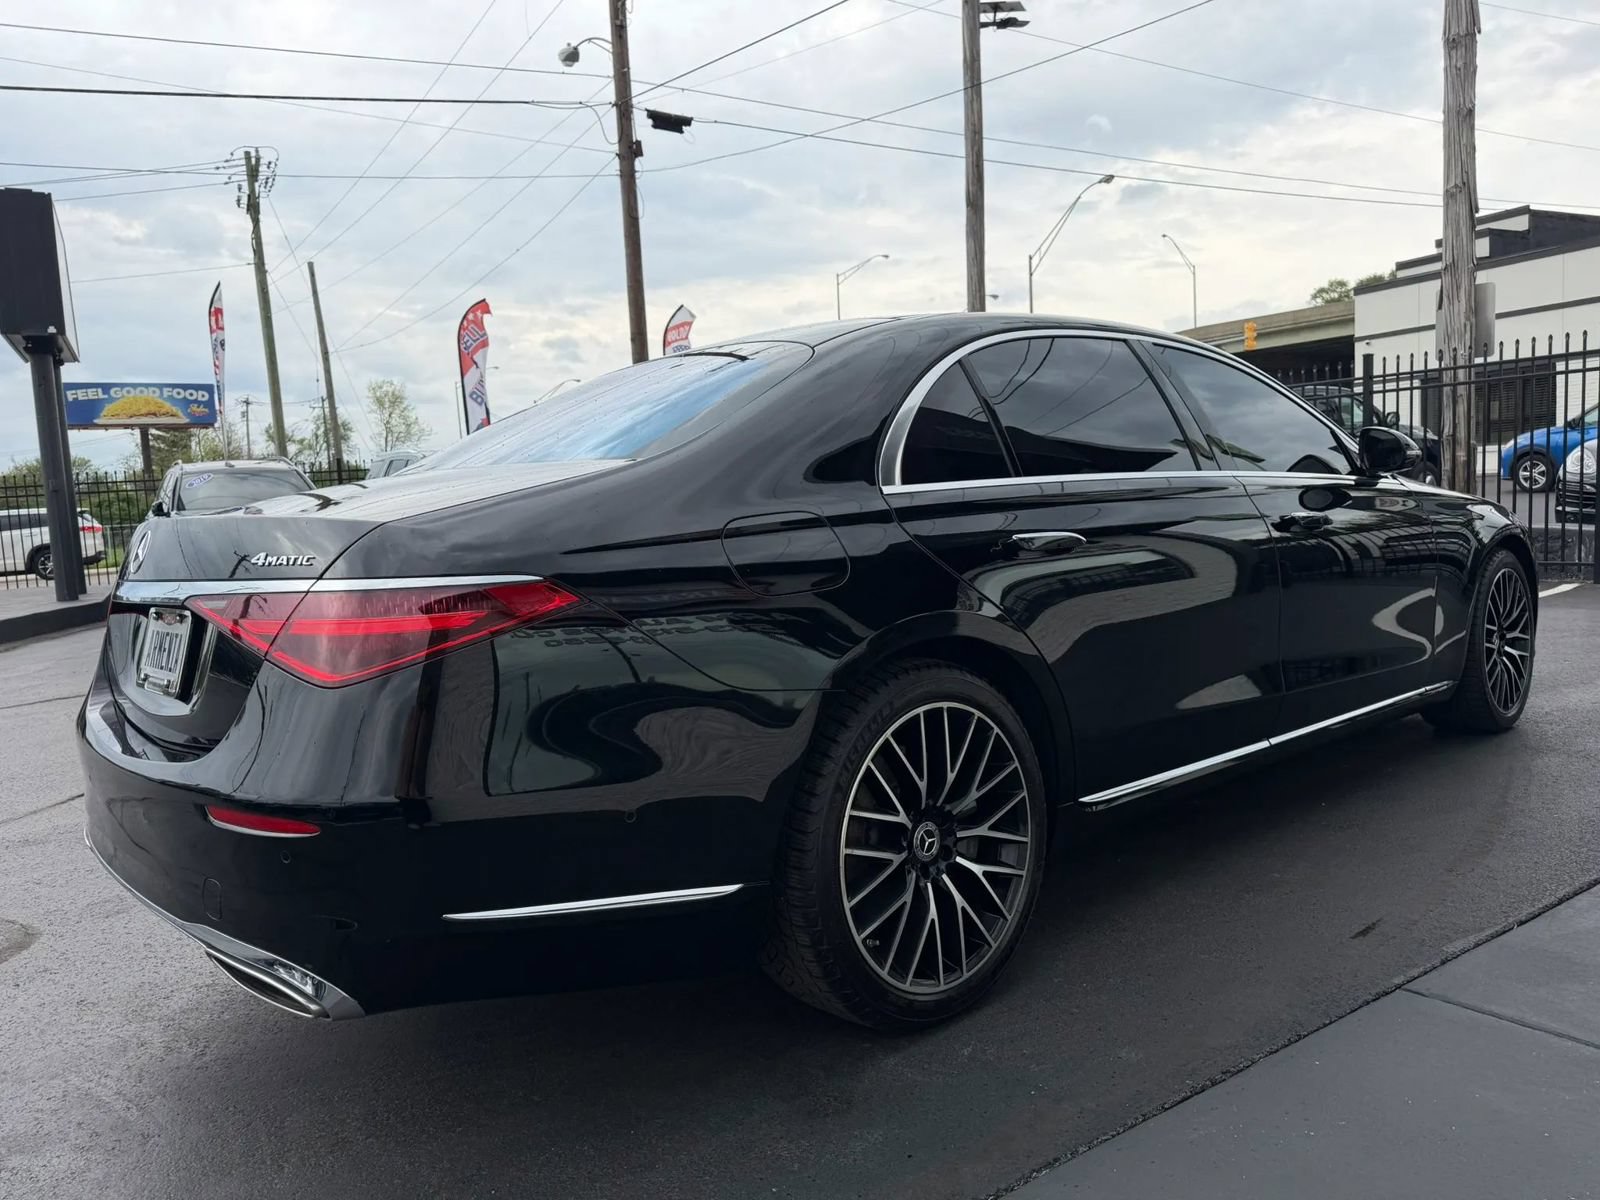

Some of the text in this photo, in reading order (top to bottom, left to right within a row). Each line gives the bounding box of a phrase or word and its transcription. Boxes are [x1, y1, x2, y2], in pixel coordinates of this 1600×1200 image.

[66, 386, 209, 401] FEEL GOOD FOOD
[250, 551, 316, 567] 4MATIC
